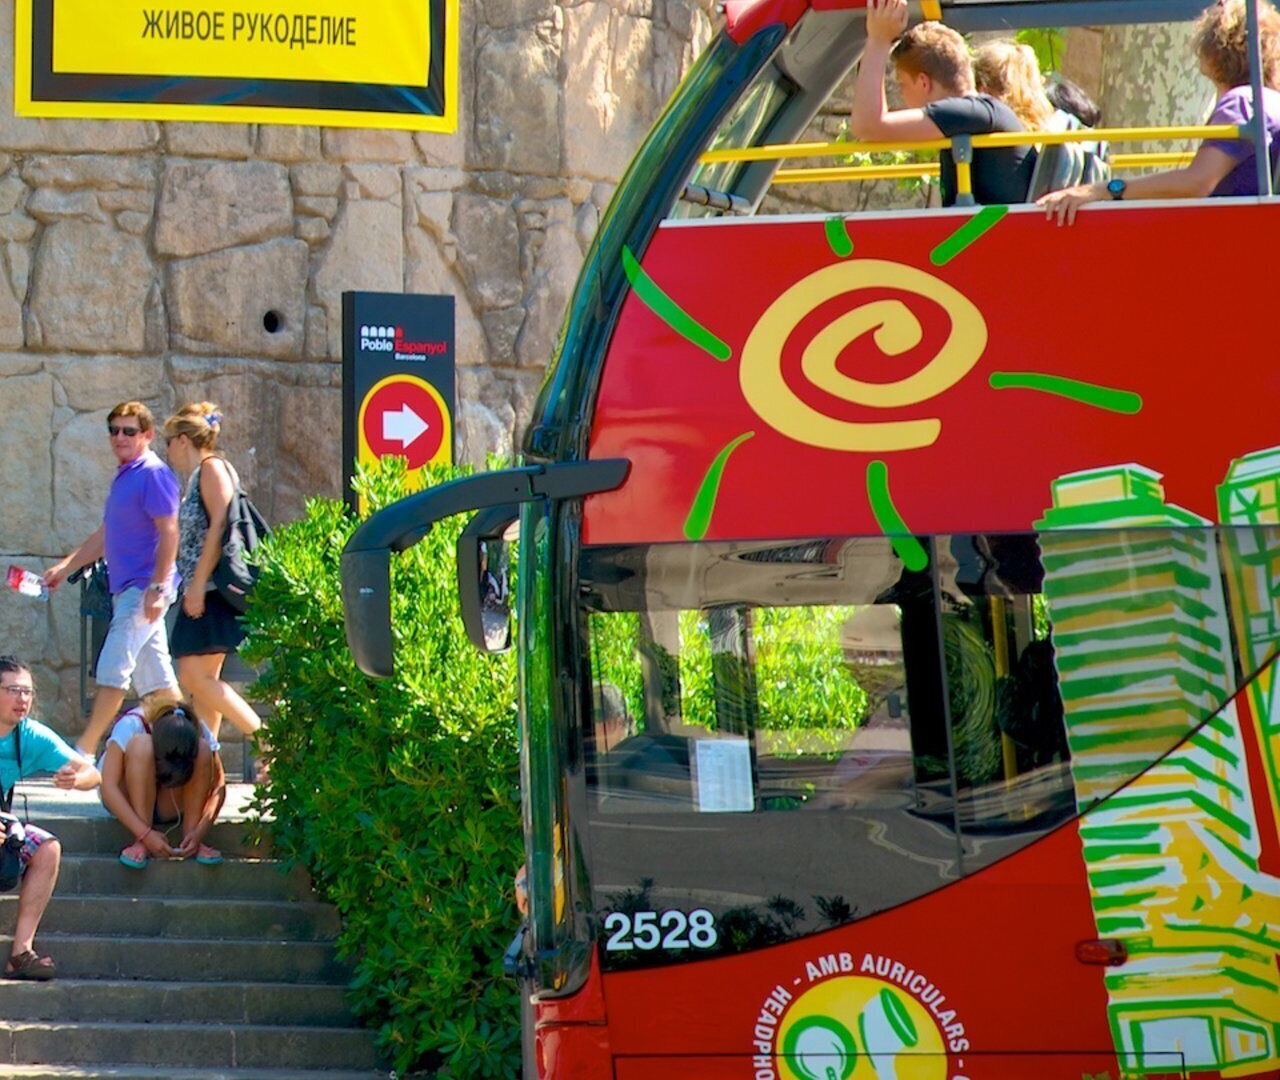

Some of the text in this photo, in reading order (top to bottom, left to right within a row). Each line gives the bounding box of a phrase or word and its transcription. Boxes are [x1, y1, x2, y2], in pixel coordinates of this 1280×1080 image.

[142, 10, 356, 50] ЖИВОЕ РУКОДЕЛИЕ
[361, 338, 448, 355] Poble Espanyol
[605, 909, 717, 951] 2528
[805, 952, 853, 982] AMB
[860, 953, 970, 1053] AURICULARS
